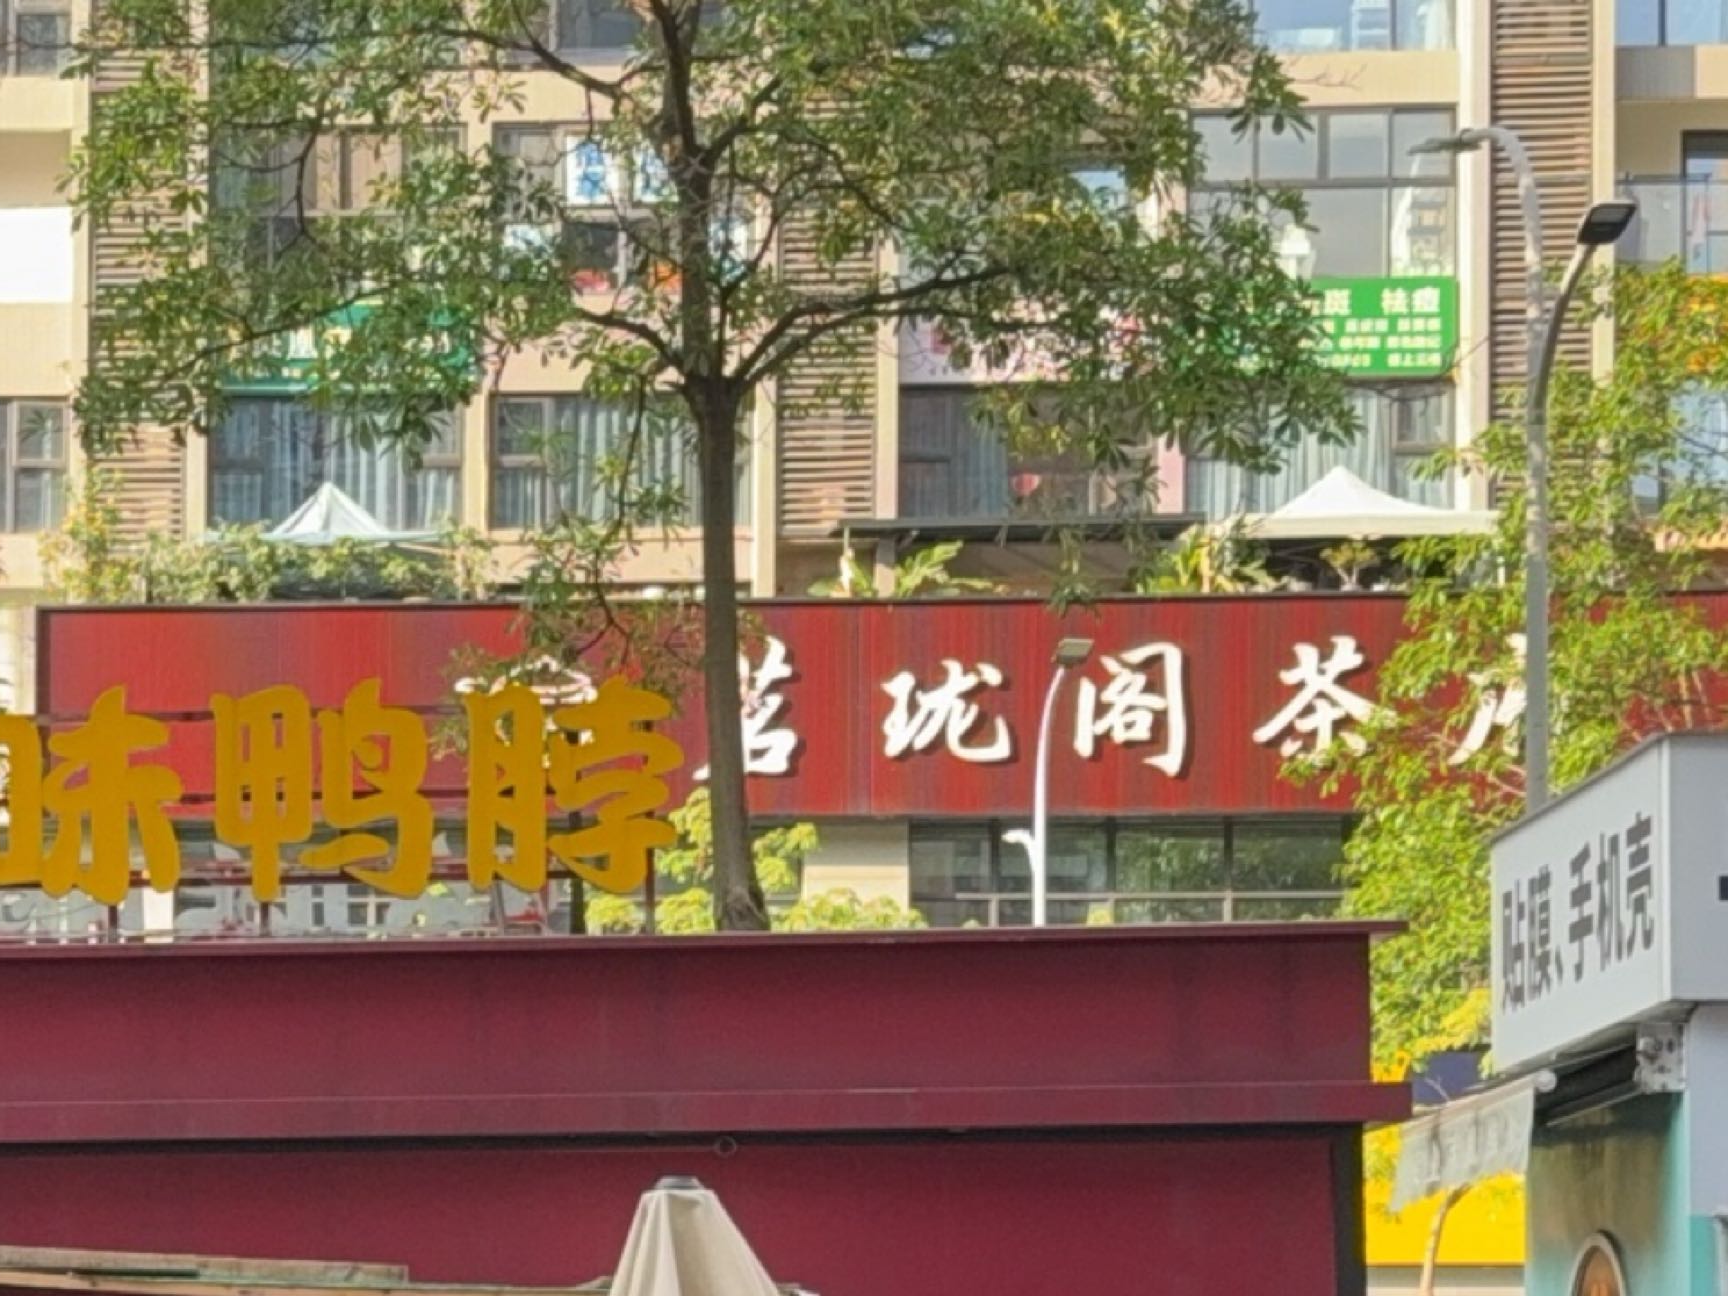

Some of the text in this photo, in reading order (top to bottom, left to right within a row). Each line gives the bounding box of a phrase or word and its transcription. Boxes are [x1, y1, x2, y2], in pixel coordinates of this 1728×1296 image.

[1501, 811, 1655, 1013] 贴膜、手机壳
